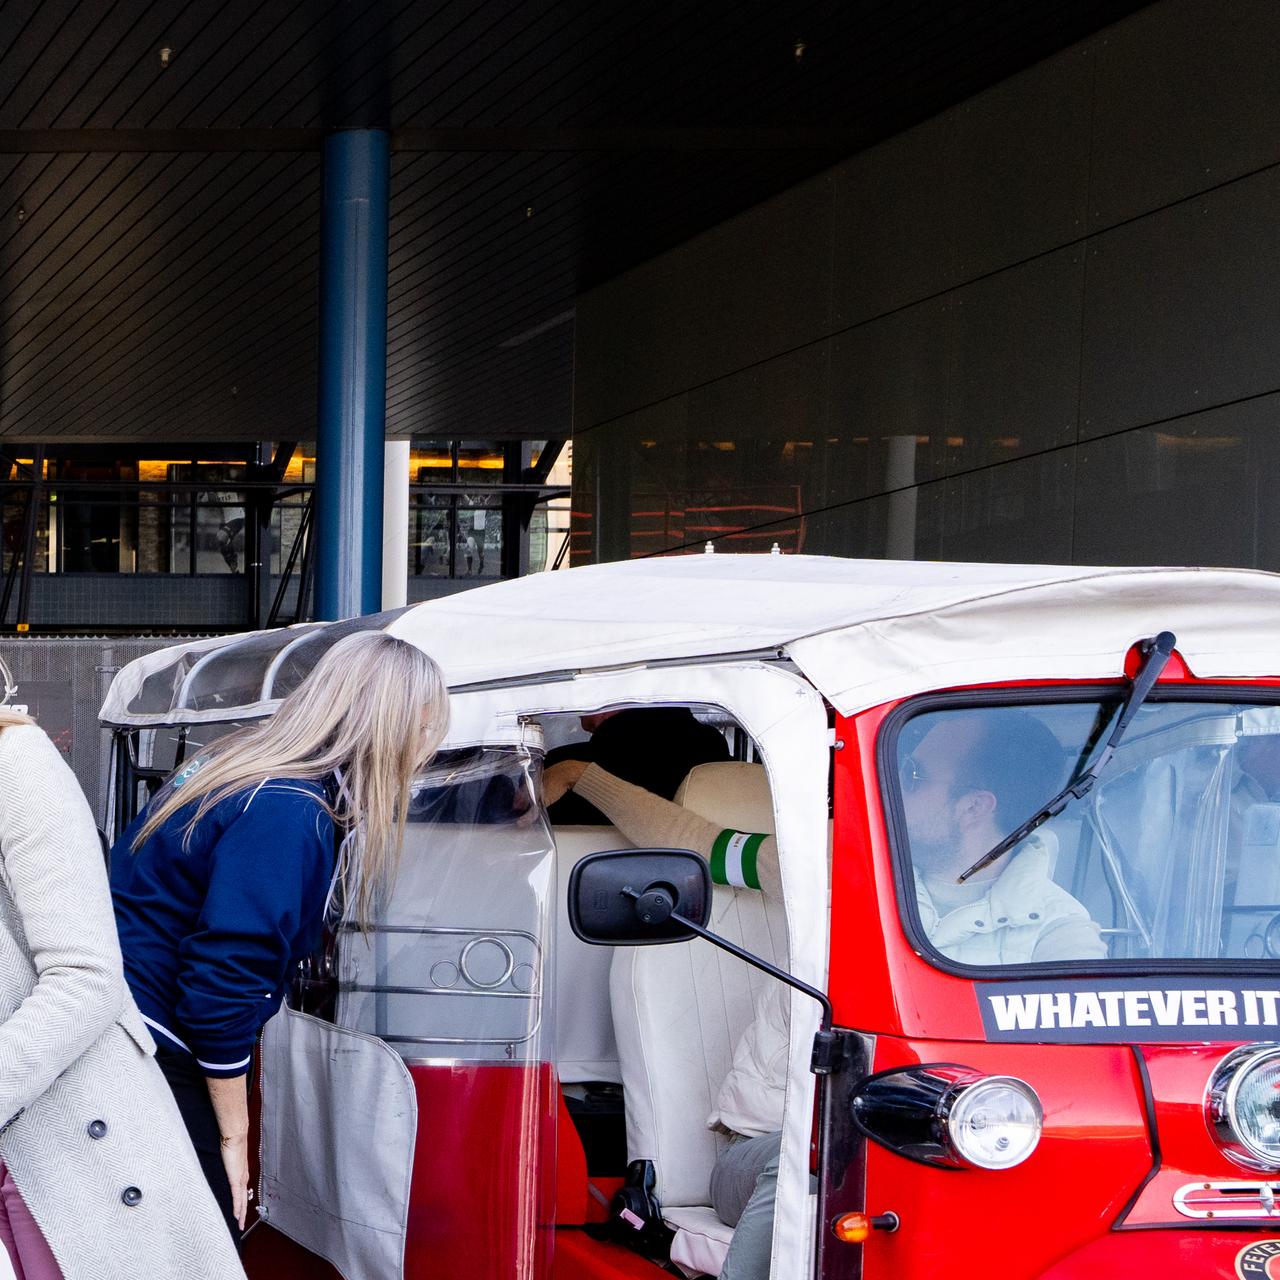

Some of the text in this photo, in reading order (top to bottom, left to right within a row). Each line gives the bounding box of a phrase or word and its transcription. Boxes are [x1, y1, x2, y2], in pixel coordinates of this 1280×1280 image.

[988, 990, 1280, 1031] WHATEVER IT
[1243, 1242, 1280, 1272] FEYE
